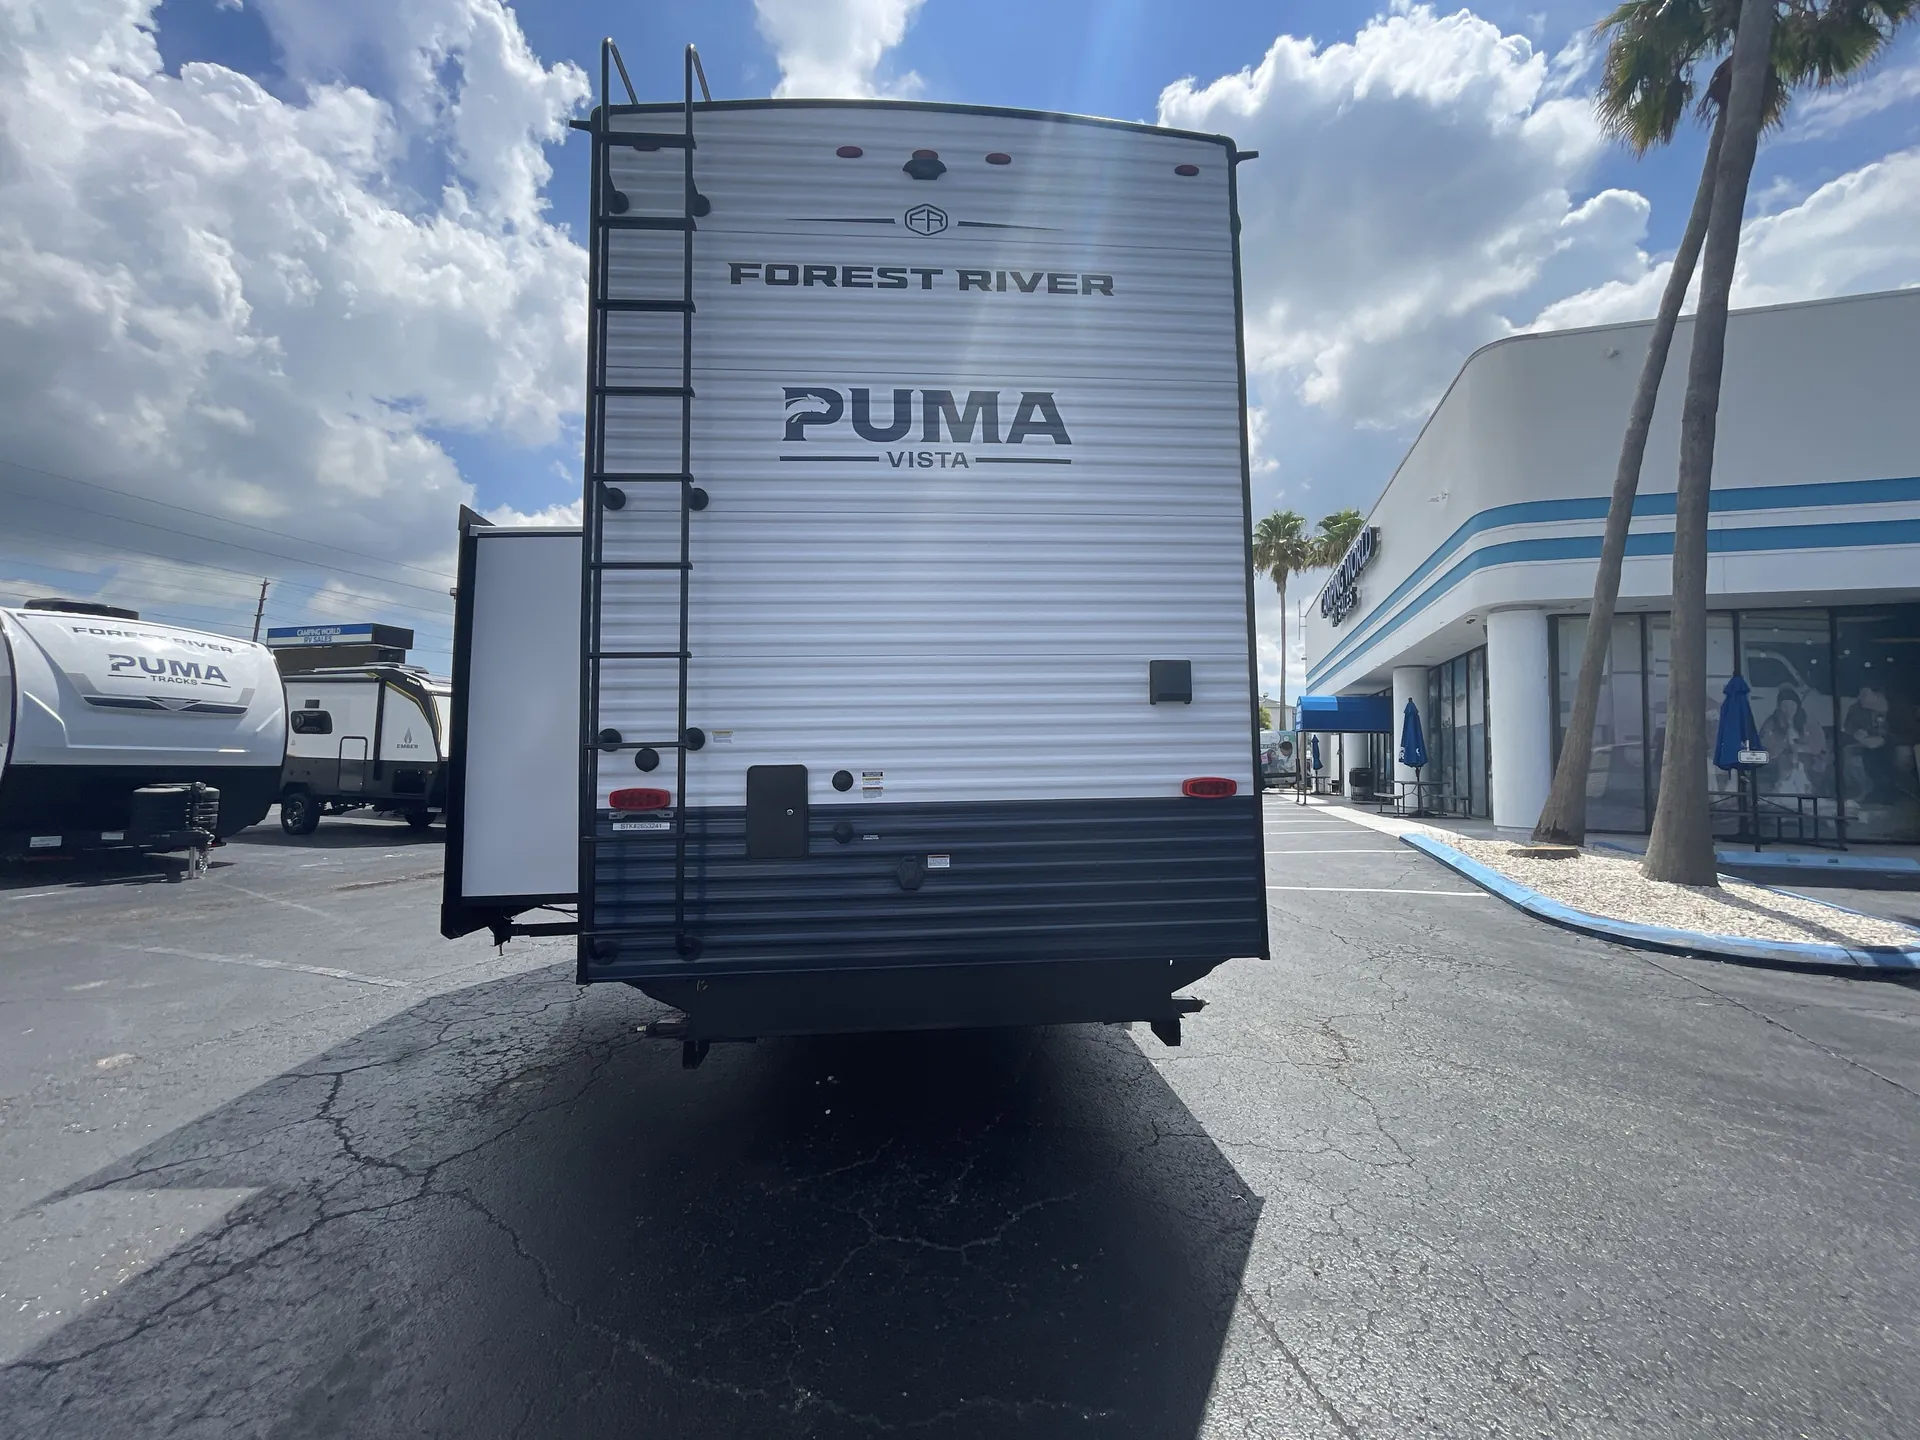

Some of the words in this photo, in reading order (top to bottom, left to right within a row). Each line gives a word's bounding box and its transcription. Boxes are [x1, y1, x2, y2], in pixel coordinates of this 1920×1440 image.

[728, 262, 944, 290] FOREST
[955, 268, 1115, 297] RIVER
[781, 386, 1073, 446] PUMA
[886, 450, 970, 469] VISTA
[1343, 525, 1373, 587] WORLD
[296, 628, 321, 637] CAMPING
[321, 627, 342, 636] WORLD
[313, 635, 333, 643] SALES
[172, 637, 235, 653] RIVER
[107, 653, 229, 683] PUMA
[150, 675, 198, 686] TRACKS
